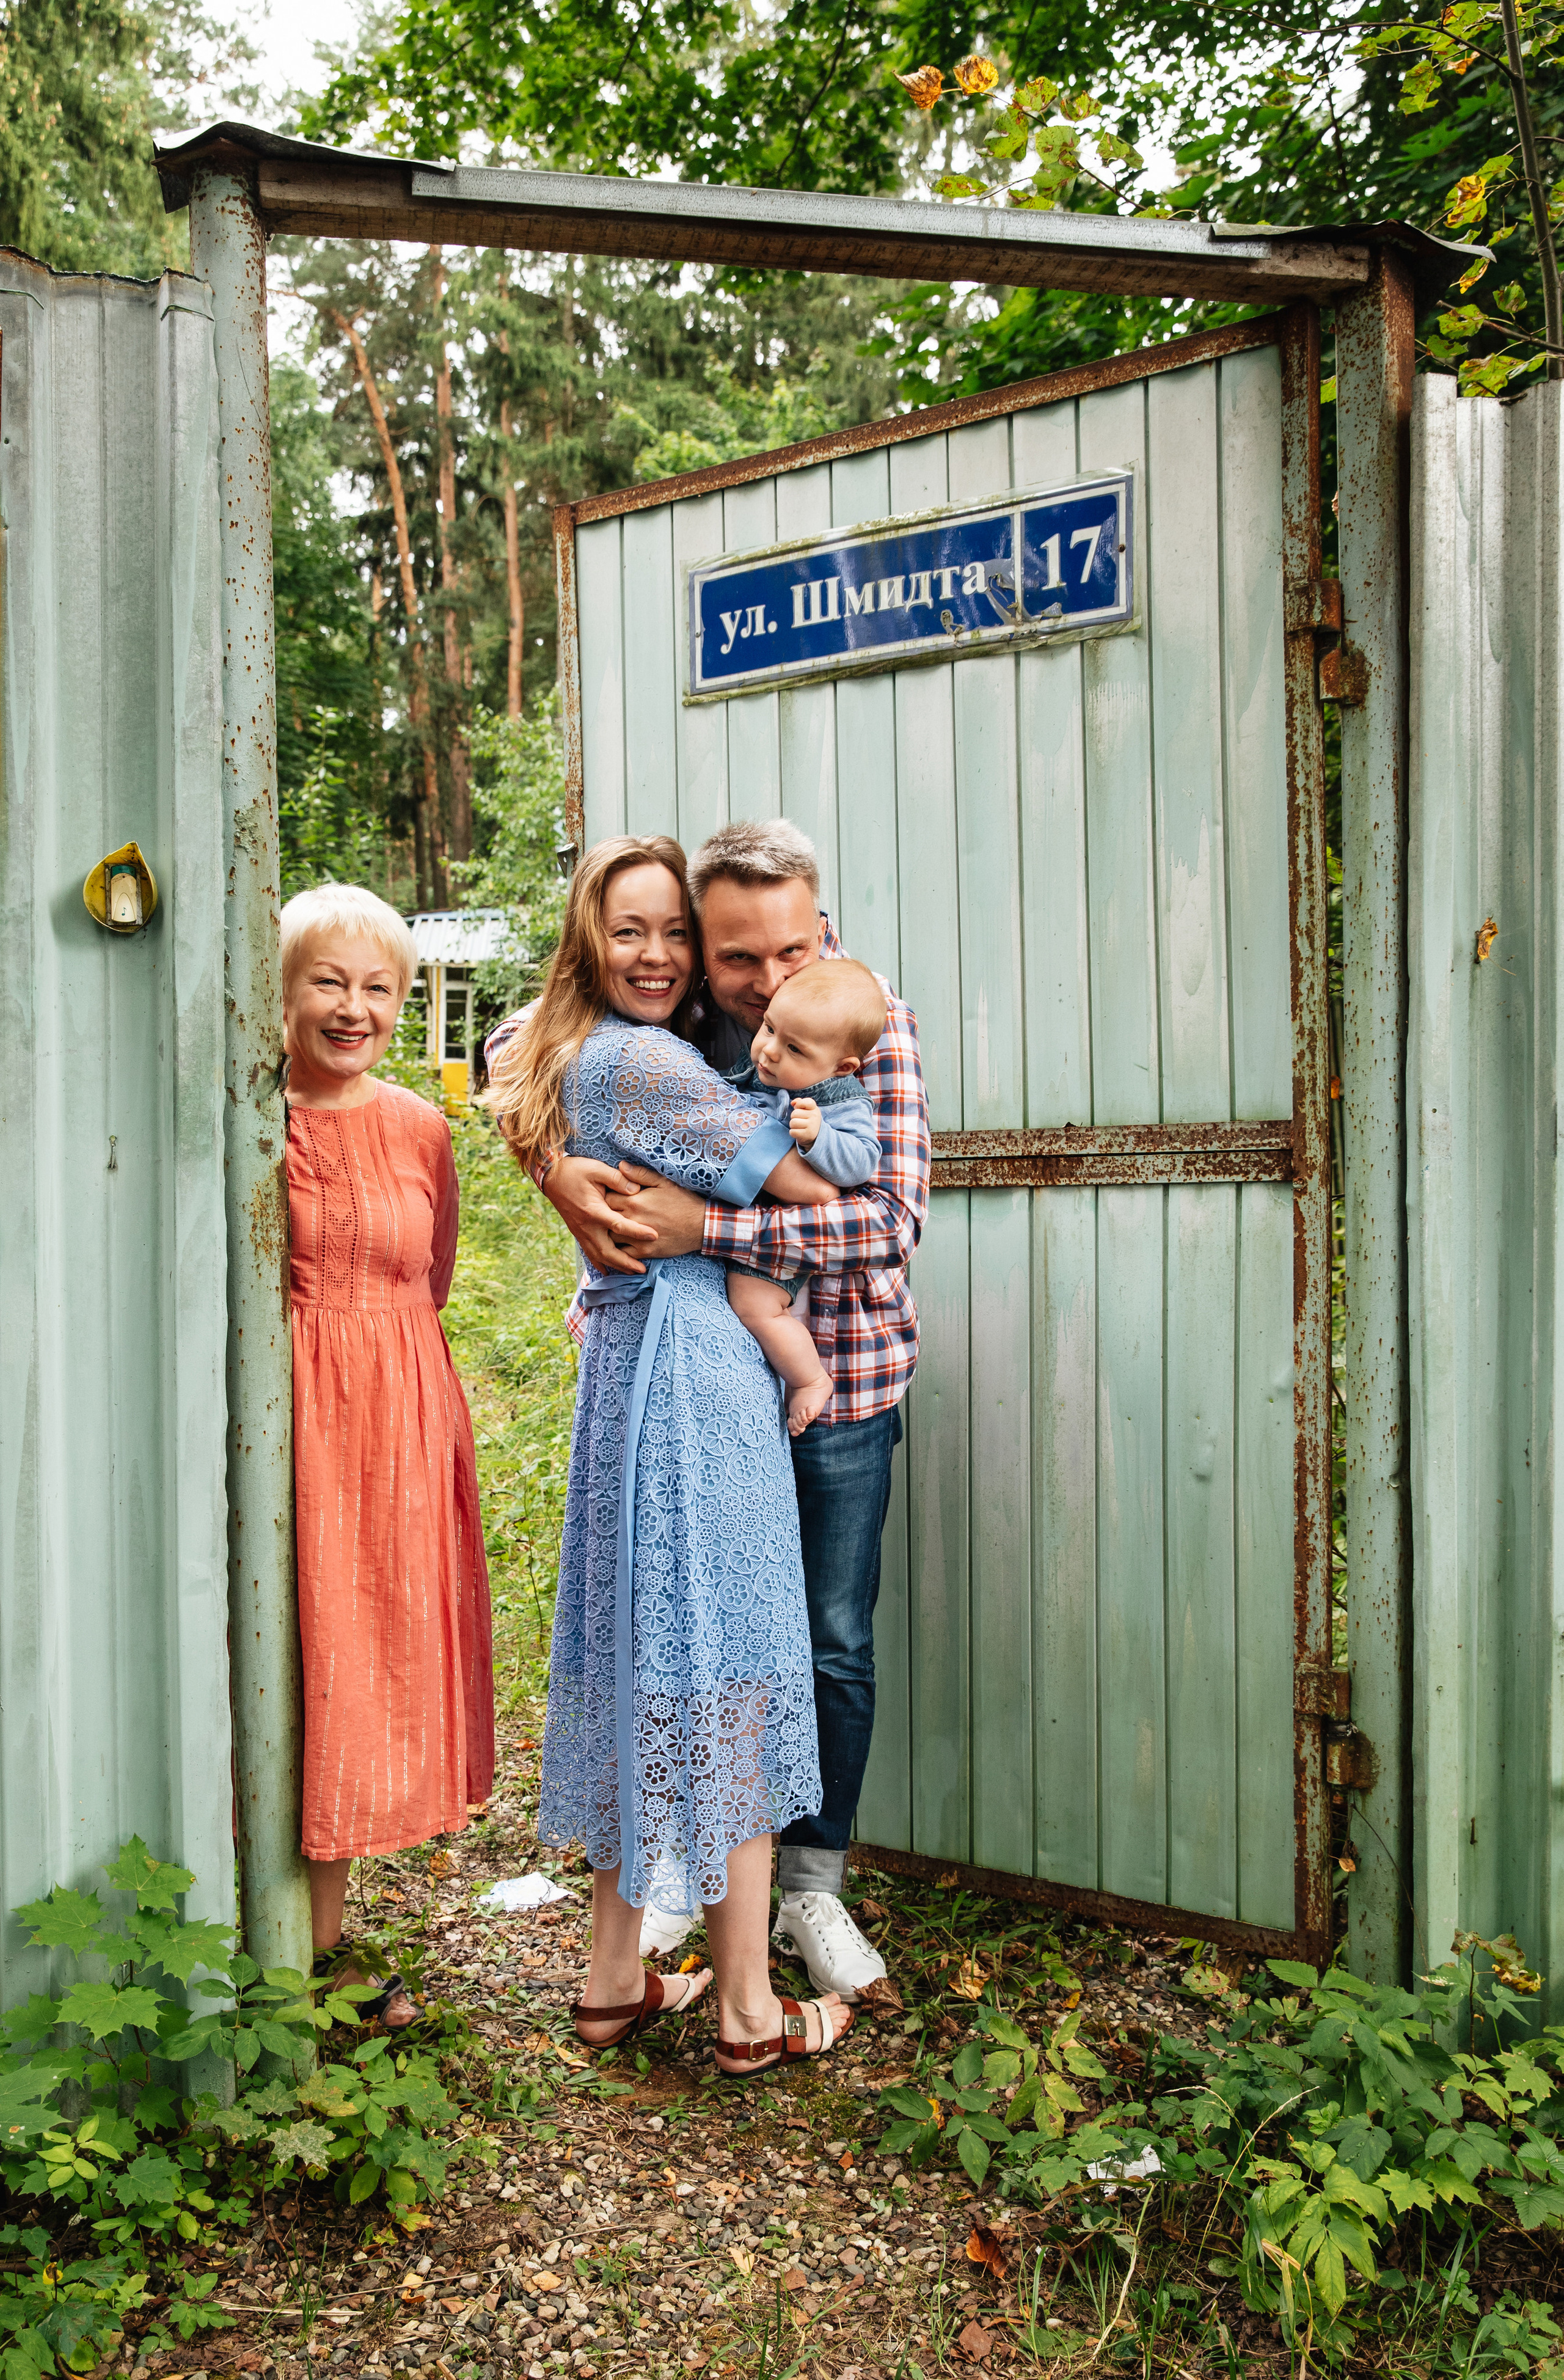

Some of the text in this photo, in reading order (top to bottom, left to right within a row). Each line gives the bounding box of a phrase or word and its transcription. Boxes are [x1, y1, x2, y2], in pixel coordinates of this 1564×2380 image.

[719, 525, 1103, 654] ул. Шмидта 17
